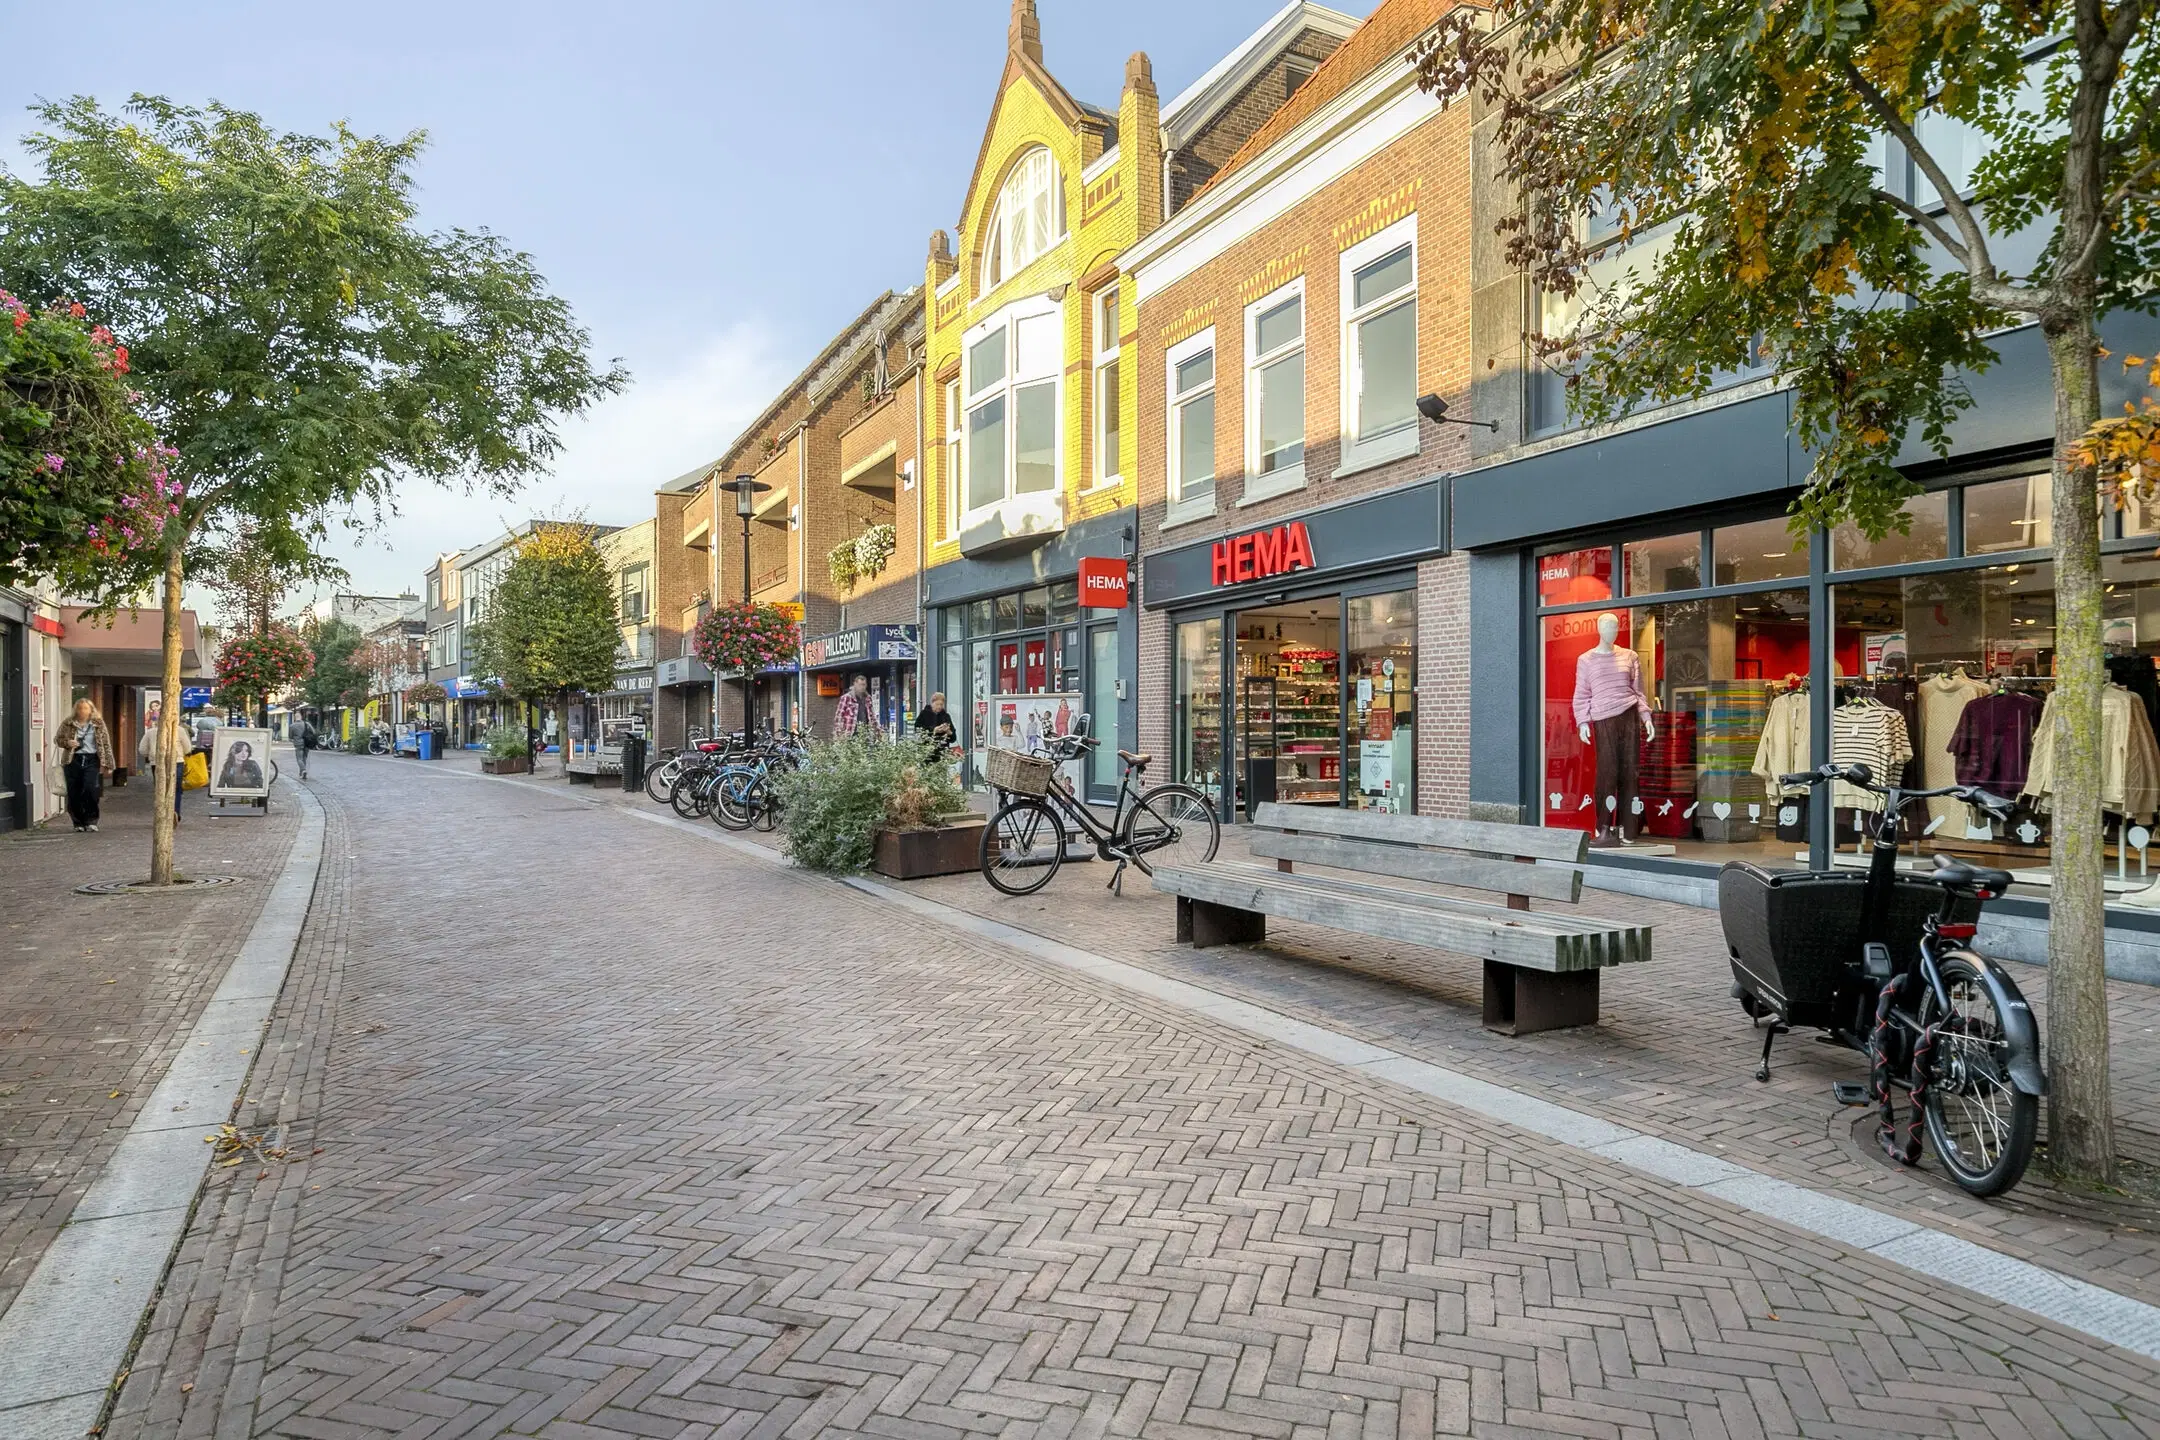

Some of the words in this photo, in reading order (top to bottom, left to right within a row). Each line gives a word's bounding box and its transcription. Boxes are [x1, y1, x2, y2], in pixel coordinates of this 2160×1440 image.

[1212, 521, 1316, 586] HEMA
[1542, 568, 1569, 581] HEMA
[1087, 575, 1125, 590] HEMA
[805, 640, 826, 667] GSM
[825, 631, 861, 657] HILLEGOM
[629, 678, 637, 690] DE
[638, 677, 653, 689] REEP
